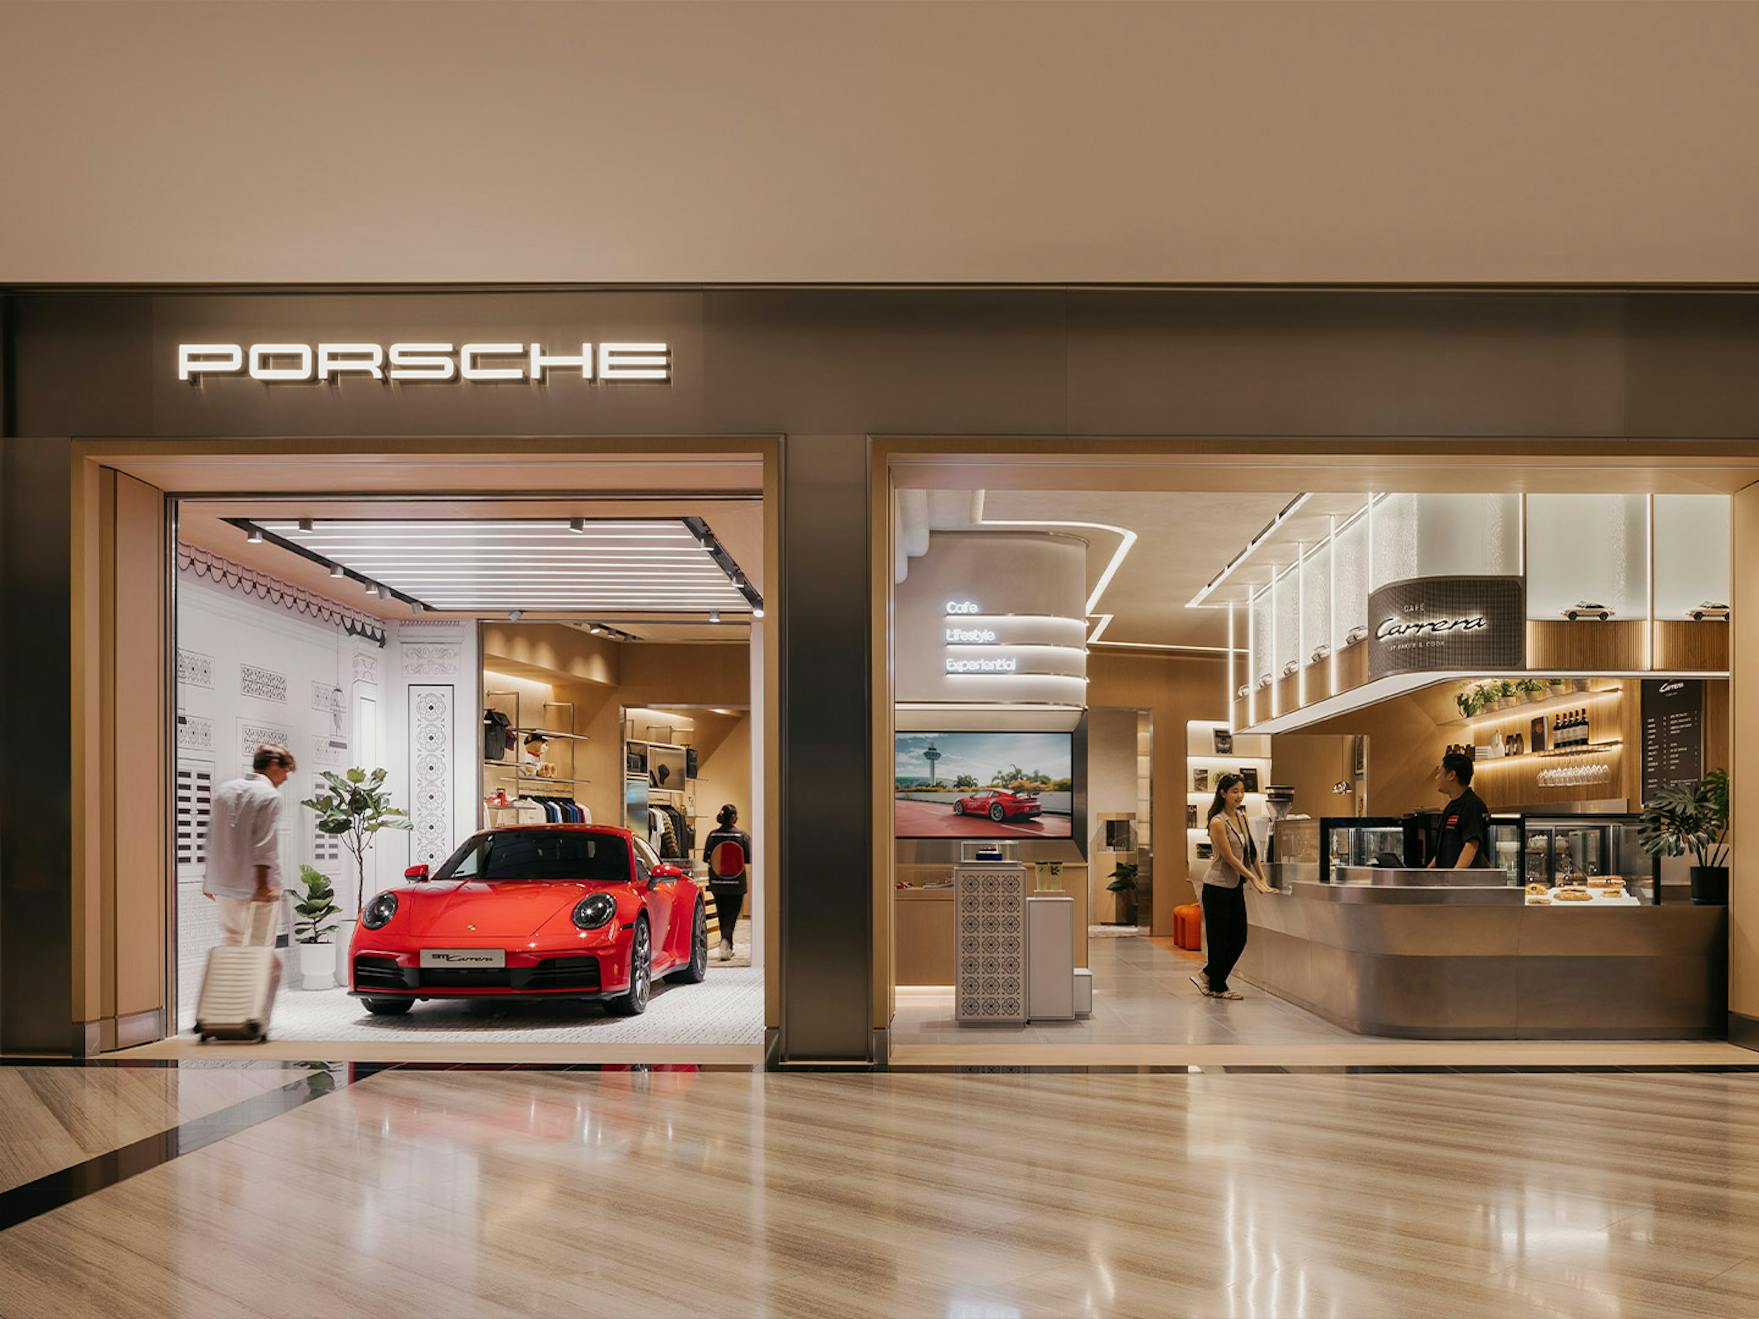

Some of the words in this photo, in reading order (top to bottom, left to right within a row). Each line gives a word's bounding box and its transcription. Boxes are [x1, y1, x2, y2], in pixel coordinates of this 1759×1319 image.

[178, 342, 668, 381] PORSCHE
[946, 601, 979, 614] Cafe
[1375, 616, 1486, 640] Carrera
[945, 629, 996, 643] Lifestyle
[945, 658, 1016, 673] Experiential
[446, 954, 494, 962] Carrera
